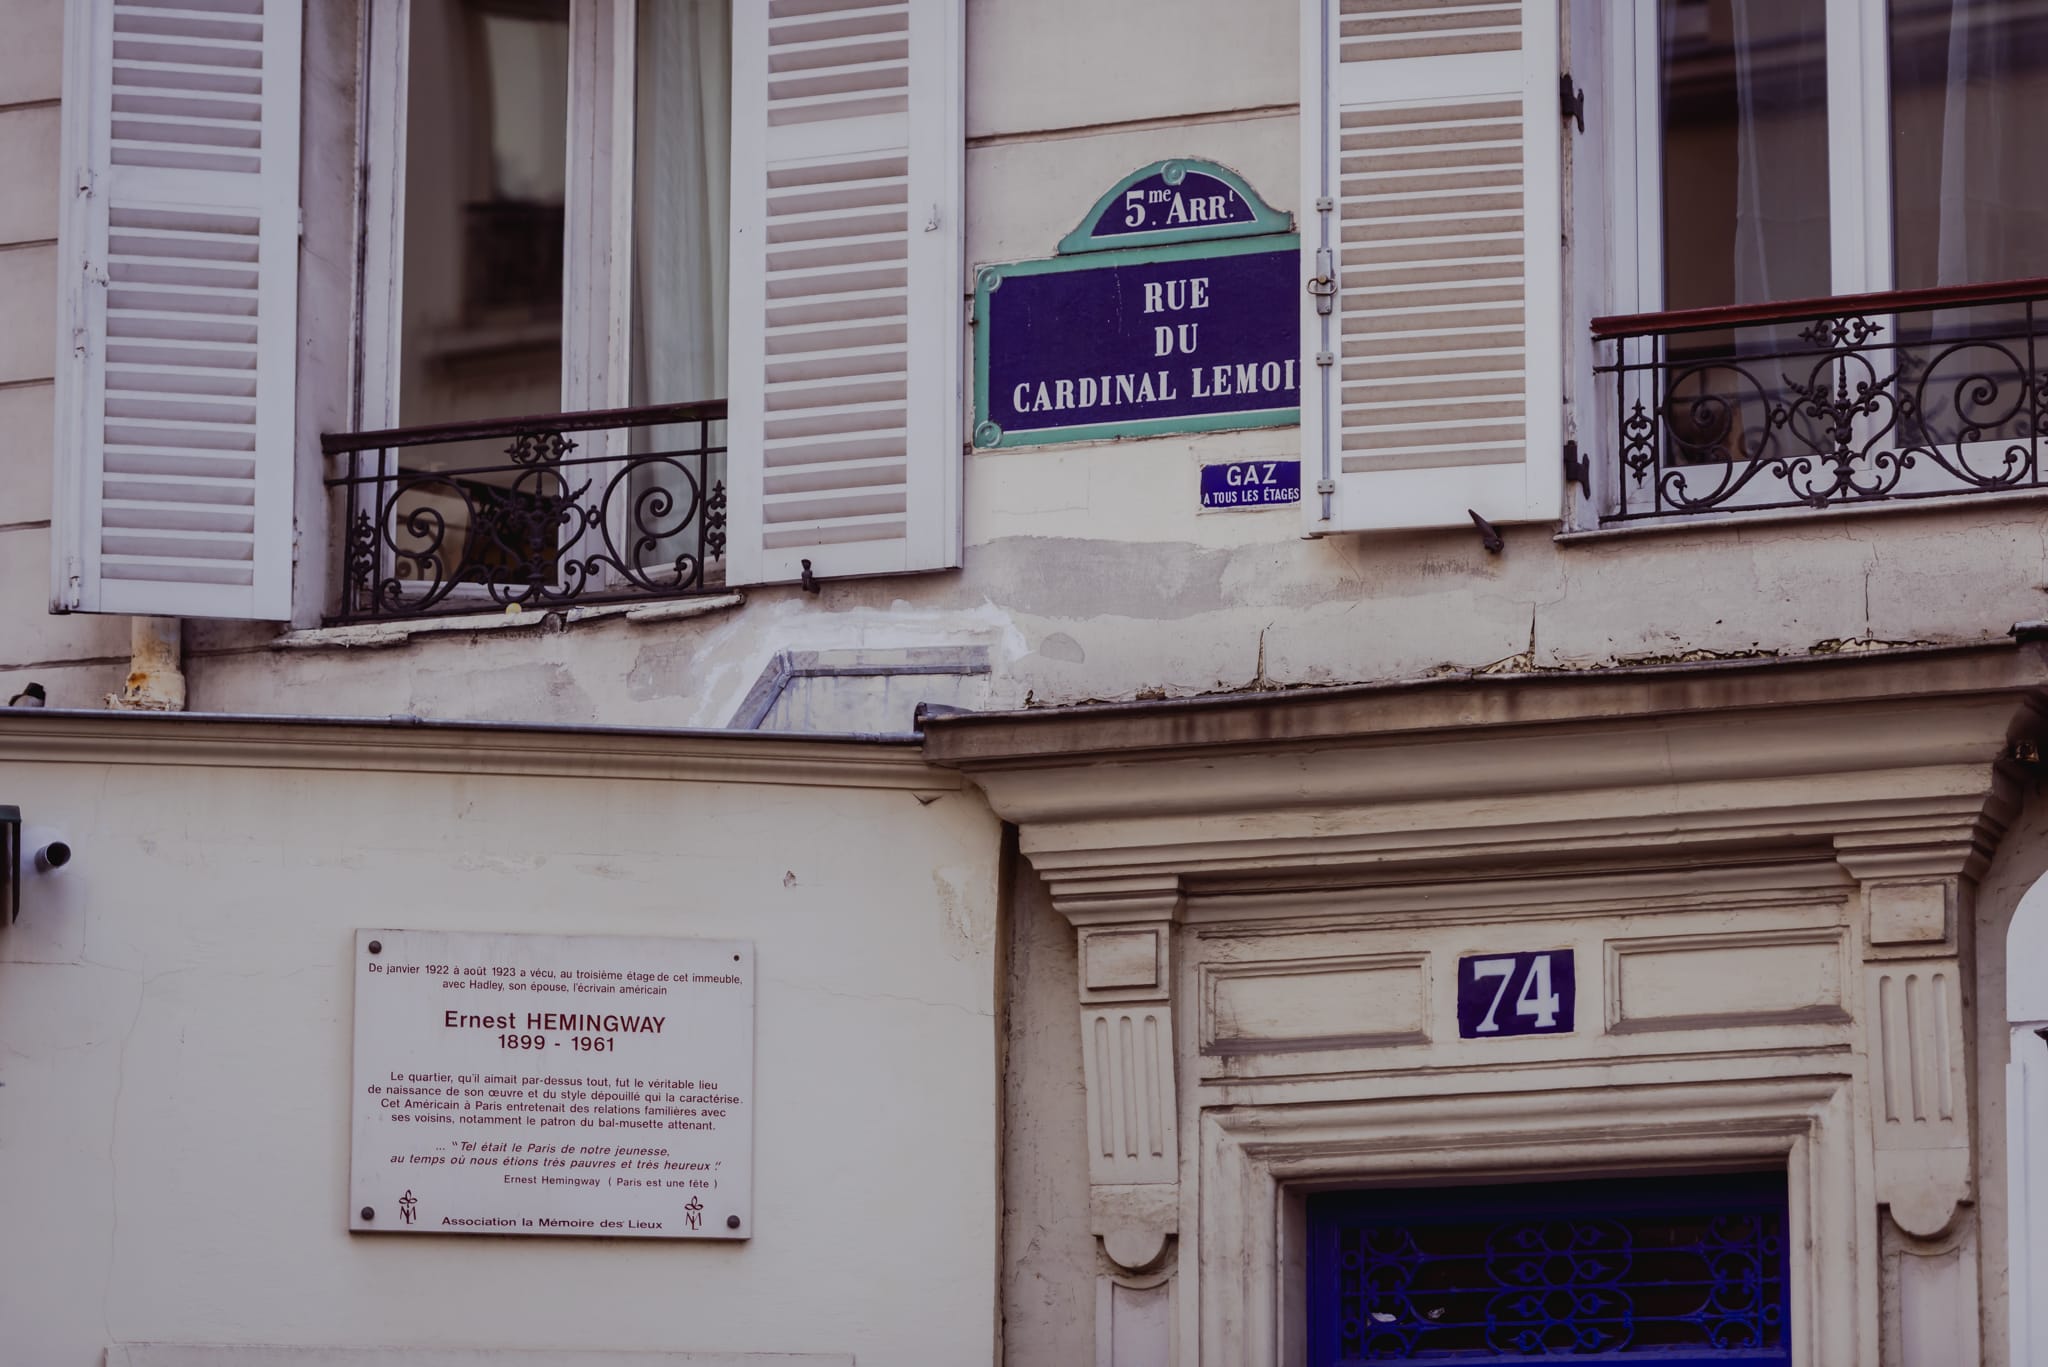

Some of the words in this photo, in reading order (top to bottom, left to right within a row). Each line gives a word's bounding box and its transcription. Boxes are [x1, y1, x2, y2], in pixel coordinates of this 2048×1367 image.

[1143, 277, 1209, 314] RUE
[1154, 323, 1199, 357] DU
[1013, 370, 1177, 413] CARDINAL
[1191, 359, 1301, 398] LEMOI
[1226, 463, 1278, 487] GAZ
[1203, 492, 1211, 505] A
[1212, 491, 1238, 504] TOUS
[1241, 490, 1259, 502] LES
[1263, 487, 1300, 501] ÉTAGES
[368, 962, 383, 973] De
[386, 963, 420, 975] janvier
[425, 964, 450, 975] 1922
[453, 965, 460, 975] à
[463, 966, 487, 976] août
[491, 966, 517, 977] 1923
[519, 969, 527, 978] a
[529, 967, 557, 980] vécu,
[559, 970, 573, 979] au
[576, 969, 623, 981] troisième
[626, 970, 656, 983] étage
[656, 972, 670, 982] de
[672, 973, 689, 983] cet
[692, 973, 743, 985] immeuble,
[442, 980, 466, 989] avec
[469, 979, 505, 992] Hadley,
[508, 982, 527, 991] son
[530, 980, 570, 993] épouse,
[573, 982, 616, 993] l'écrivain
[619, 984, 668, 995] américain
[1474, 955, 1560, 1032] 74
[444, 1009, 517, 1030] Ernest
[527, 1012, 666, 1034] HEMINGWAY
[497, 1033, 546, 1051] 1899
[570, 1035, 614, 1052] 1961
[390, 1071, 404, 1082] Le
[408, 1072, 454, 1084] quartier,
[457, 1073, 480, 1085] qu'il
[483, 1073, 518, 1085] aimait
[521, 1075, 583, 1087] par-dessus
[586, 1077, 612, 1089] tout,
[615, 1077, 630, 1088] fut
[634, 1078, 644, 1088] le
[647, 1079, 695, 1090] véritable
[698, 1079, 718, 1090] lieu
[367, 1083, 382, 1095] de
[386, 1084, 442, 1096] naissance
[445, 1085, 460, 1097] de
[464, 1088, 484, 1097] son
[527, 1088, 539, 1099] et
[542, 1088, 557, 1099] du
[560, 1089, 587, 1102] style
[590, 1089, 641, 1103] dépouillé
[644, 1091, 662, 1104] qui
[665, 1092, 676, 1103] la
[380, 1097, 401, 1109] Cet
[403, 1098, 460, 1110] Américain
[463, 1099, 471, 1111] à
[475, 1100, 503, 1111] Paris
[505, 1101, 566, 1113] entretenait
[569, 1103, 590, 1114] des
[593, 1104, 641, 1116] relations
[644, 1105, 697, 1117] familières
[700, 1109, 727, 1118] avec
[391, 1114, 411, 1122] ses
[414, 1112, 455, 1125] voisins,
[459, 1114, 522, 1125] notamment
[526, 1115, 536, 1126] le
[540, 1116, 576, 1128] patron
[579, 1116, 594, 1128] du
[598, 1117, 664, 1129] bal-musette
[667, 1119, 716, 1131] attenant.
[480, 1141, 508, 1153] était
[511, 1142, 523, 1153] le
[526, 1143, 557, 1154] Paris
[560, 1143, 576, 1155] de
[579, 1144, 611, 1156] notre
[613, 1145, 670, 1158] jeunesse,
[390, 1155, 405, 1164] au
[409, 1153, 446, 1166] temps
[450, 1154, 466, 1165] où
[469, 1157, 499, 1166] nous
[502, 1156, 539, 1167] étions
[543, 1157, 566, 1168] très
[569, 1159, 617, 1170] pauvres
[620, 1159, 633, 1169] et
[636, 1159, 660, 1170] très
[504, 1174, 537, 1185] Ernest
[541, 1175, 601, 1188] Hemingway
[616, 1177, 642, 1187] Paris
[645, 1178, 662, 1187] est
[666, 1180, 685, 1188] une
[688, 1179, 710, 1189] fête
[441, 1216, 517, 1227] Association
[521, 1217, 534, 1227] la
[538, 1217, 595, 1228] Mémoire
[599, 1219, 624, 1229] des
[628, 1219, 663, 1229] Lieux
